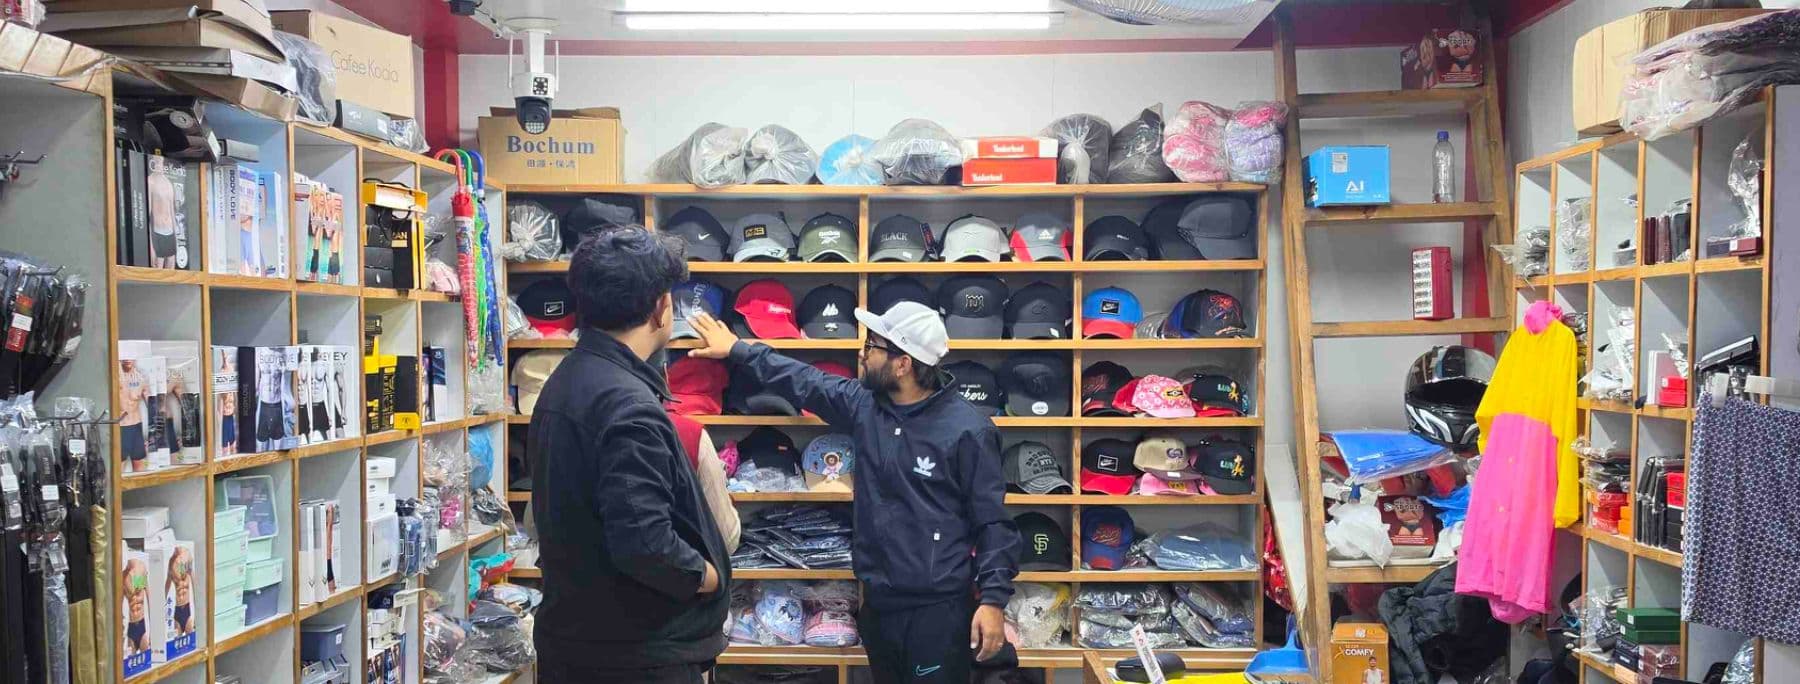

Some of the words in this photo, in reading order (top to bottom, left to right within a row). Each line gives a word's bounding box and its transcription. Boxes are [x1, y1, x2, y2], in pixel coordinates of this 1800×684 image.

[507, 135, 595, 154] Bochum
[1345, 180, 1364, 191] AI
[1345, 648, 1375, 656] COMFY
